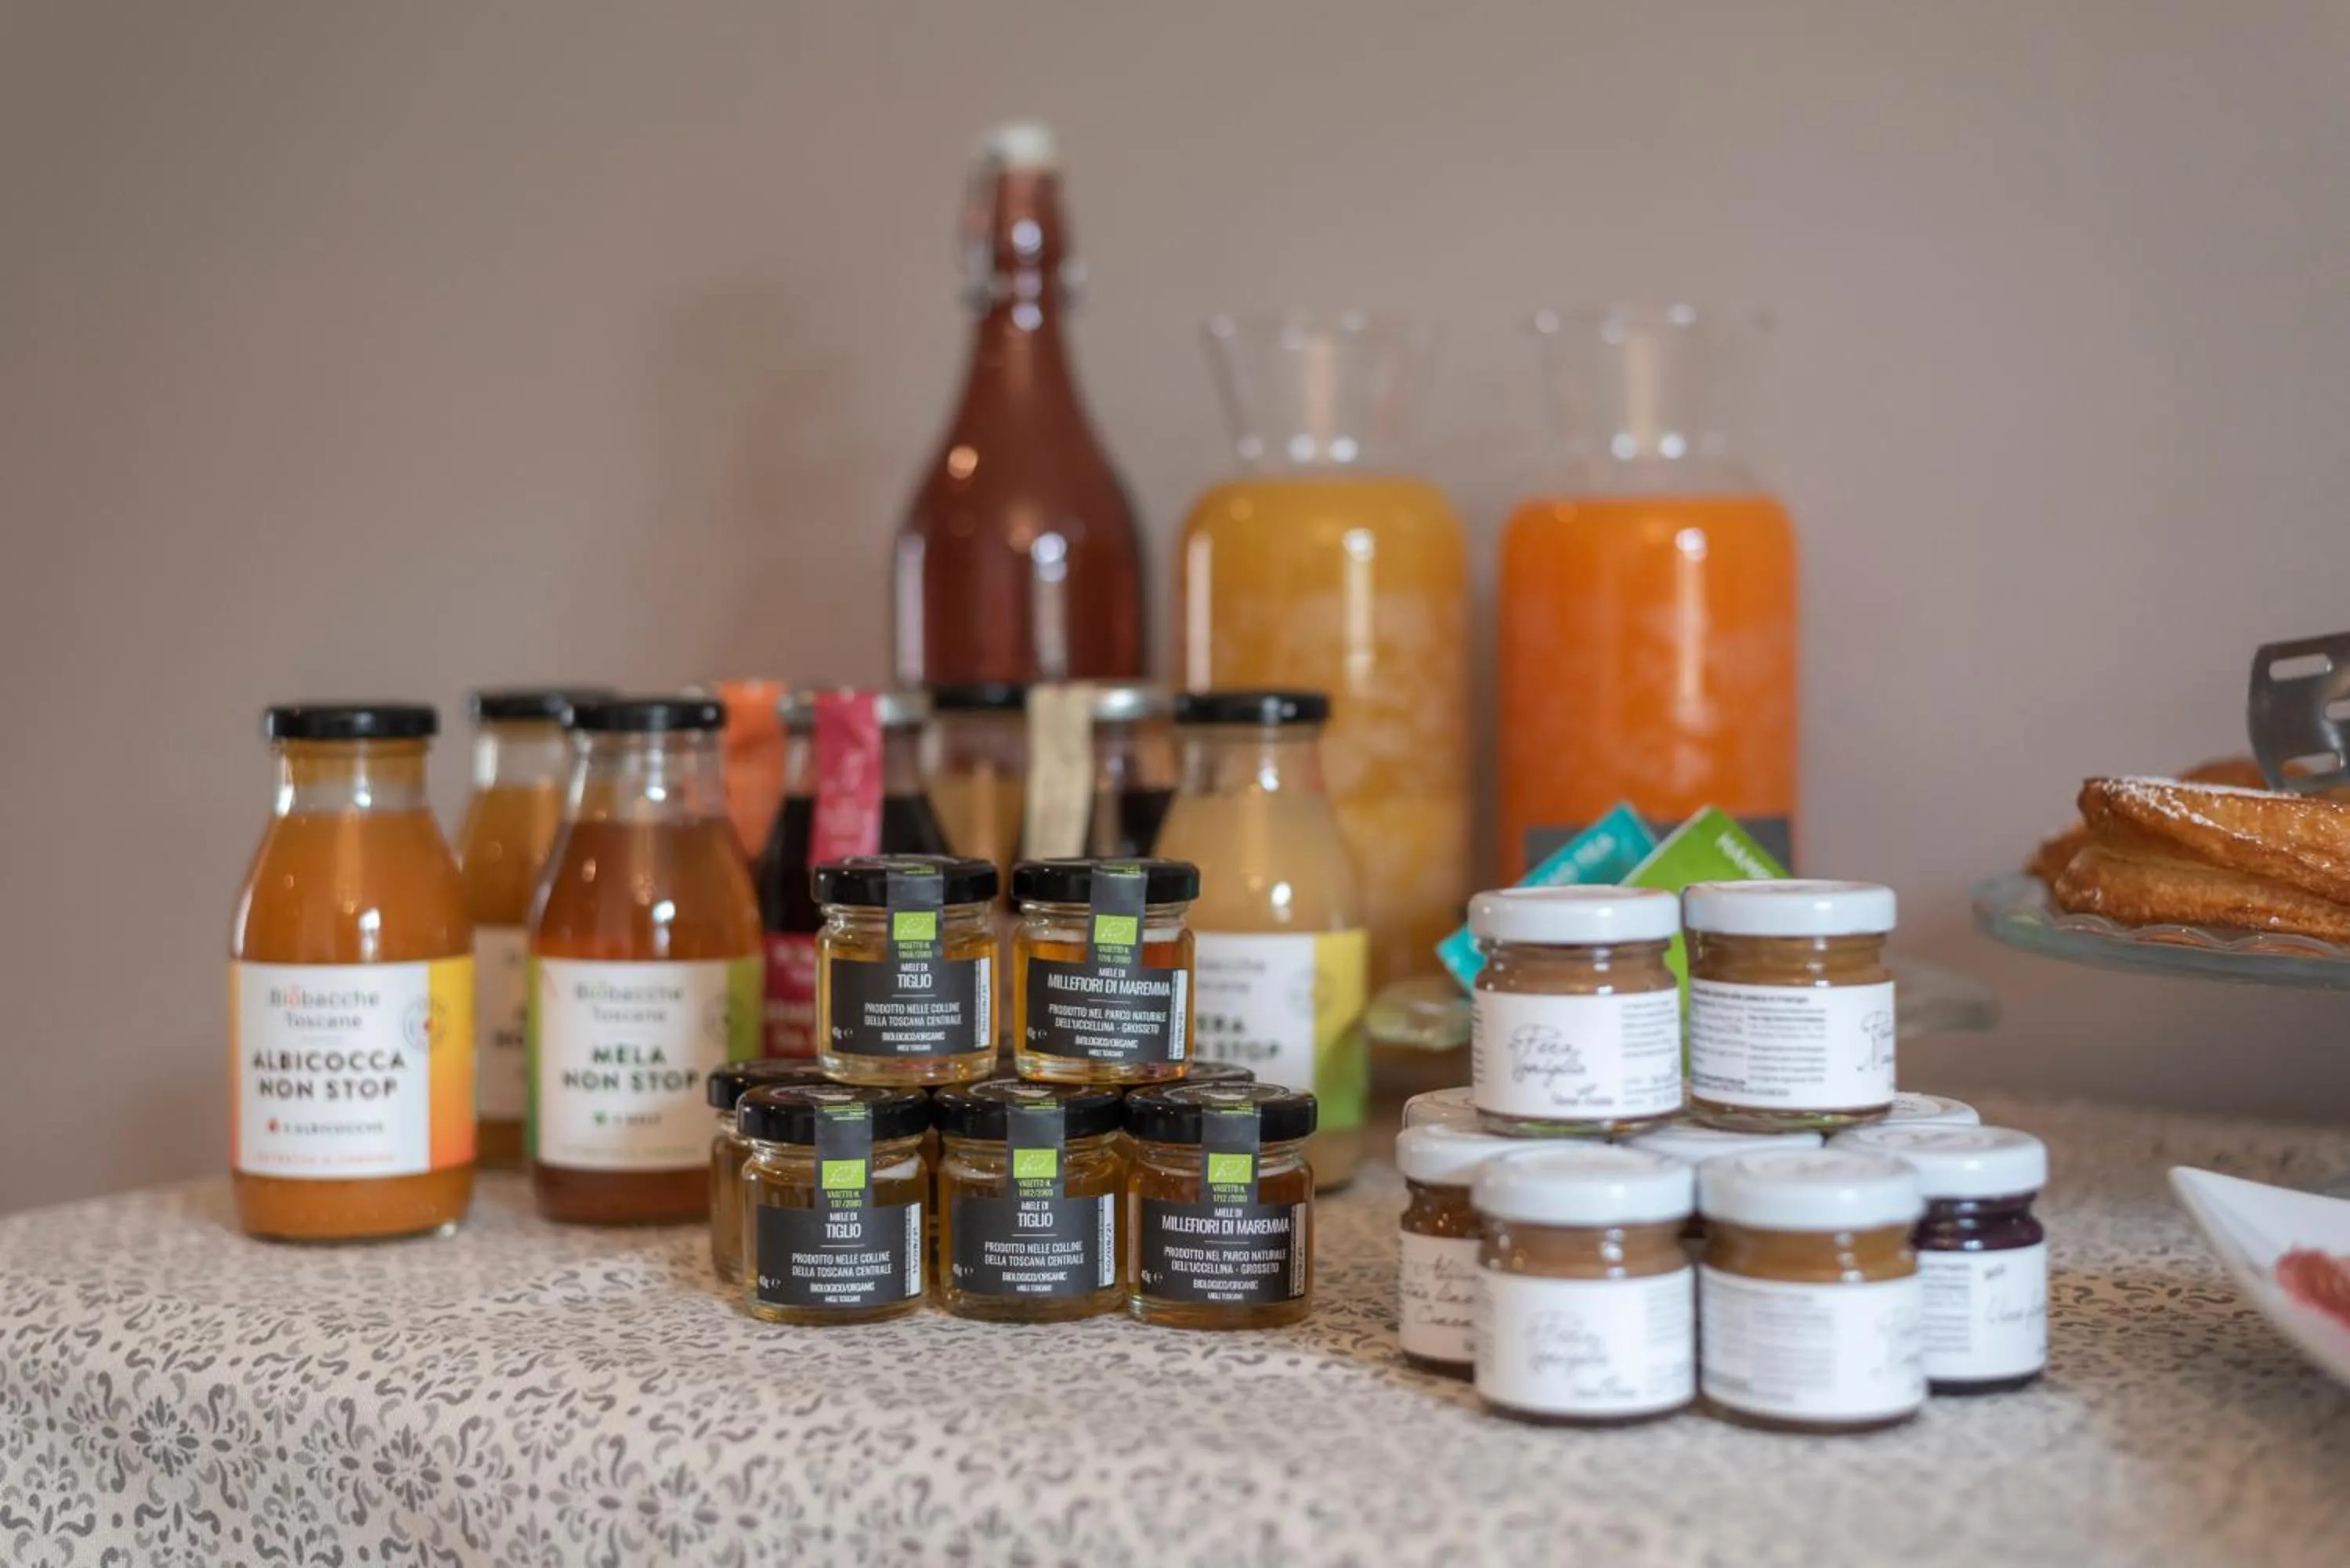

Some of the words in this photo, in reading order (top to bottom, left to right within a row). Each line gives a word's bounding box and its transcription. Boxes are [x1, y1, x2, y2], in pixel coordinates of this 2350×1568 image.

[897, 974, 932, 988] TIGLIO
[1047, 973, 1103, 993] MILLEFIORI
[1105, 979, 1117, 994] DI
[1119, 981, 1170, 996] MAREMMA
[864, 1003, 905, 1013] PRODOTTO
[906, 1003, 929, 1013] NELLE
[931, 1002, 960, 1013] COLLINE
[1049, 1003, 1087, 1017] PRODOTTO
[1088, 1008, 1103, 1019] NEL
[1104, 1009, 1131, 1020] PARCO
[1132, 1011, 1166, 1022] NATURALE
[864, 1015, 887, 1027] DELLA
[889, 1016, 924, 1026] TOSCANA
[927, 1014, 962, 1025] CENTRALE
[1121, 1023, 1160, 1035] GROSSETO
[252, 1050, 406, 1072] ALBICOCCA
[593, 1046, 666, 1064] MELA
[563, 1070, 619, 1089] NON
[631, 1071, 699, 1092] STOP
[259, 1079, 313, 1099] NON
[326, 1079, 398, 1100] STOP
[1021, 1201, 1040, 1210] MIELE
[1041, 1201, 1049, 1210] DI
[1215, 1208, 1233, 1217] MIELE
[830, 1212, 849, 1222] MIELE
[851, 1212, 858, 1221] DI
[1017, 1212, 1053, 1227] TIGLIO
[825, 1223, 862, 1238] TIGLIO
[1162, 1216, 1220, 1234] MILLEFIORI
[1222, 1219, 1234, 1234] DI
[1237, 1218, 1290, 1234] MAREMMA
[985, 1241, 1025, 1253] PRODOTTO
[1027, 1243, 1050, 1253] NELLE
[1052, 1241, 1083, 1252] COLLINE
[1164, 1247, 1204, 1260] PRODOTTO
[1206, 1250, 1220, 1261] NEL
[1223, 1250, 1249, 1261] PARCO
[1251, 1248, 1286, 1261] NATURALE
[792, 1253, 833, 1265] PRODOTTO
[836, 1253, 859, 1265] NELLE
[860, 1251, 890, 1263] COLLINE
[985, 1254, 1007, 1266] DELLA
[1009, 1255, 1046, 1266] TOSCANA
[1047, 1253, 1084, 1266] CENTRALE
[792, 1266, 815, 1277] DELLA
[817, 1266, 854, 1277] TOSCANA
[855, 1263, 891, 1276] CENTRALE
[1171, 1260, 1233, 1274] DELL'UCCELLINA
[1240, 1263, 1279, 1274] GROSSETO
[1002, 1271, 1067, 1281] BIOLOGICO/ORGANIC
[810, 1281, 875, 1292] BIOLOGICO/ORGANIC
[1193, 1278, 1259, 1291] BIOLOGICO/ORGANIC
